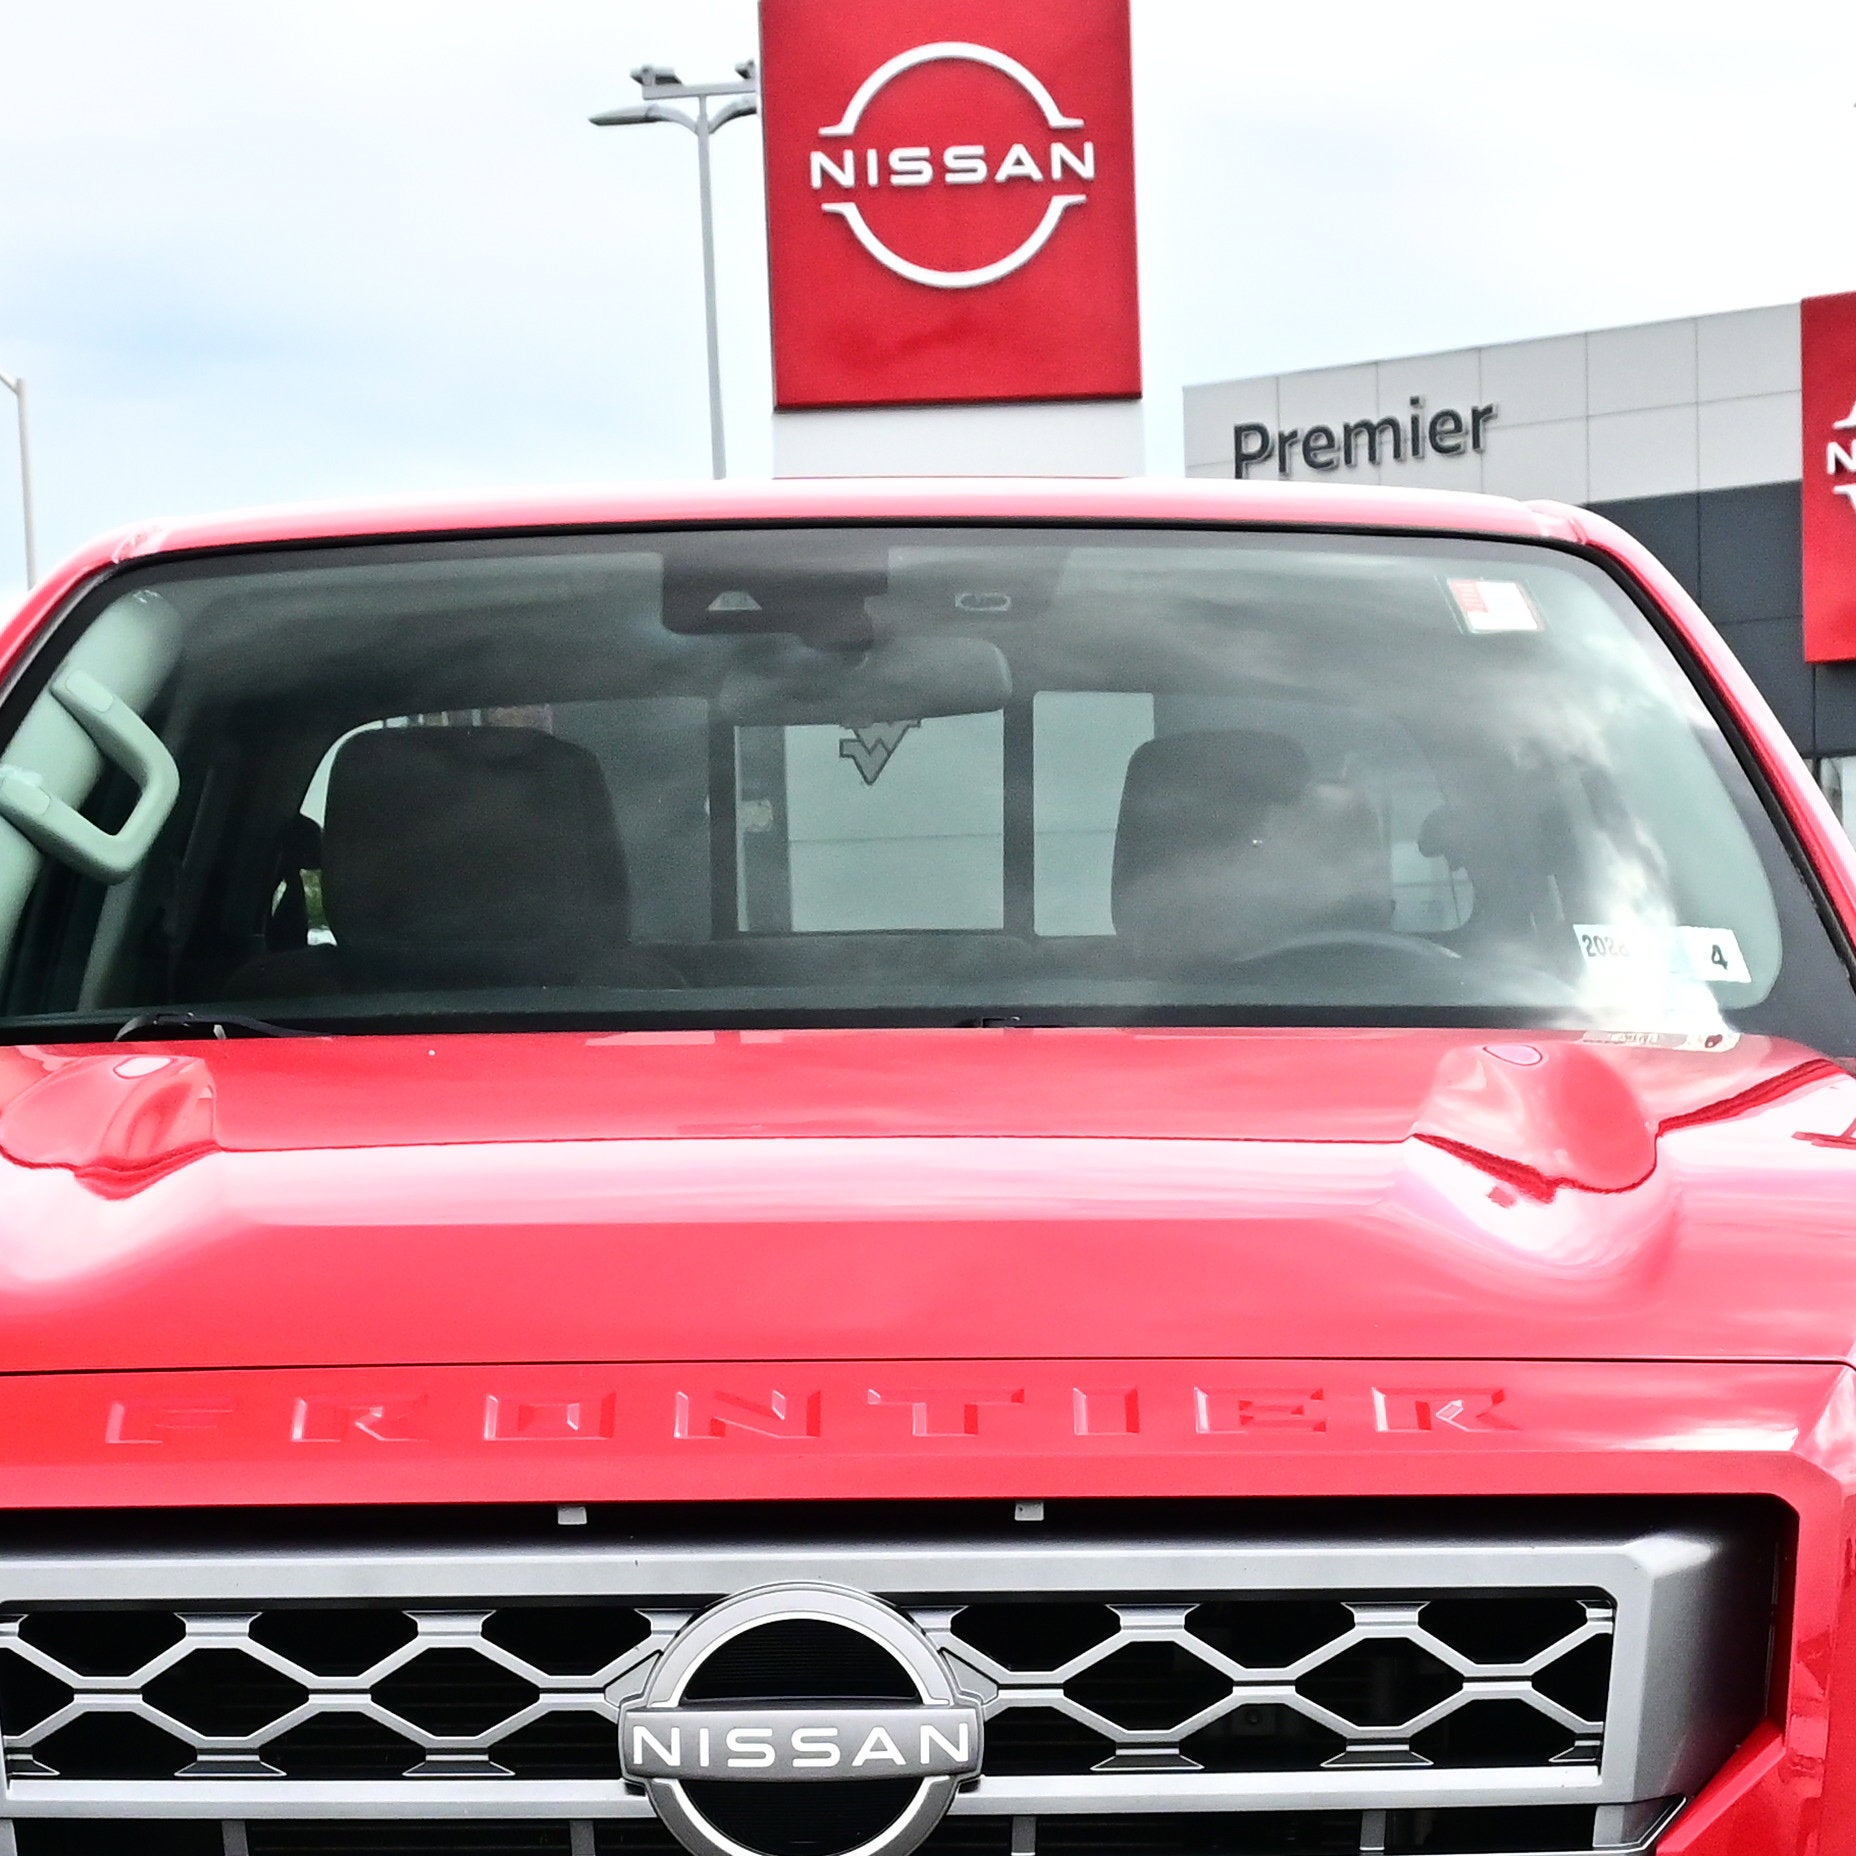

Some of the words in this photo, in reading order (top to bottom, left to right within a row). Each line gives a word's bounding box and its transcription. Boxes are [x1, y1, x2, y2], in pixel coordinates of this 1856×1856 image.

[808, 139, 1097, 192] NISSAN
[1233, 395, 1498, 479] Premier
[102, 1383, 1526, 1447] FRONTIER
[631, 1721, 971, 1769] NISSAN
